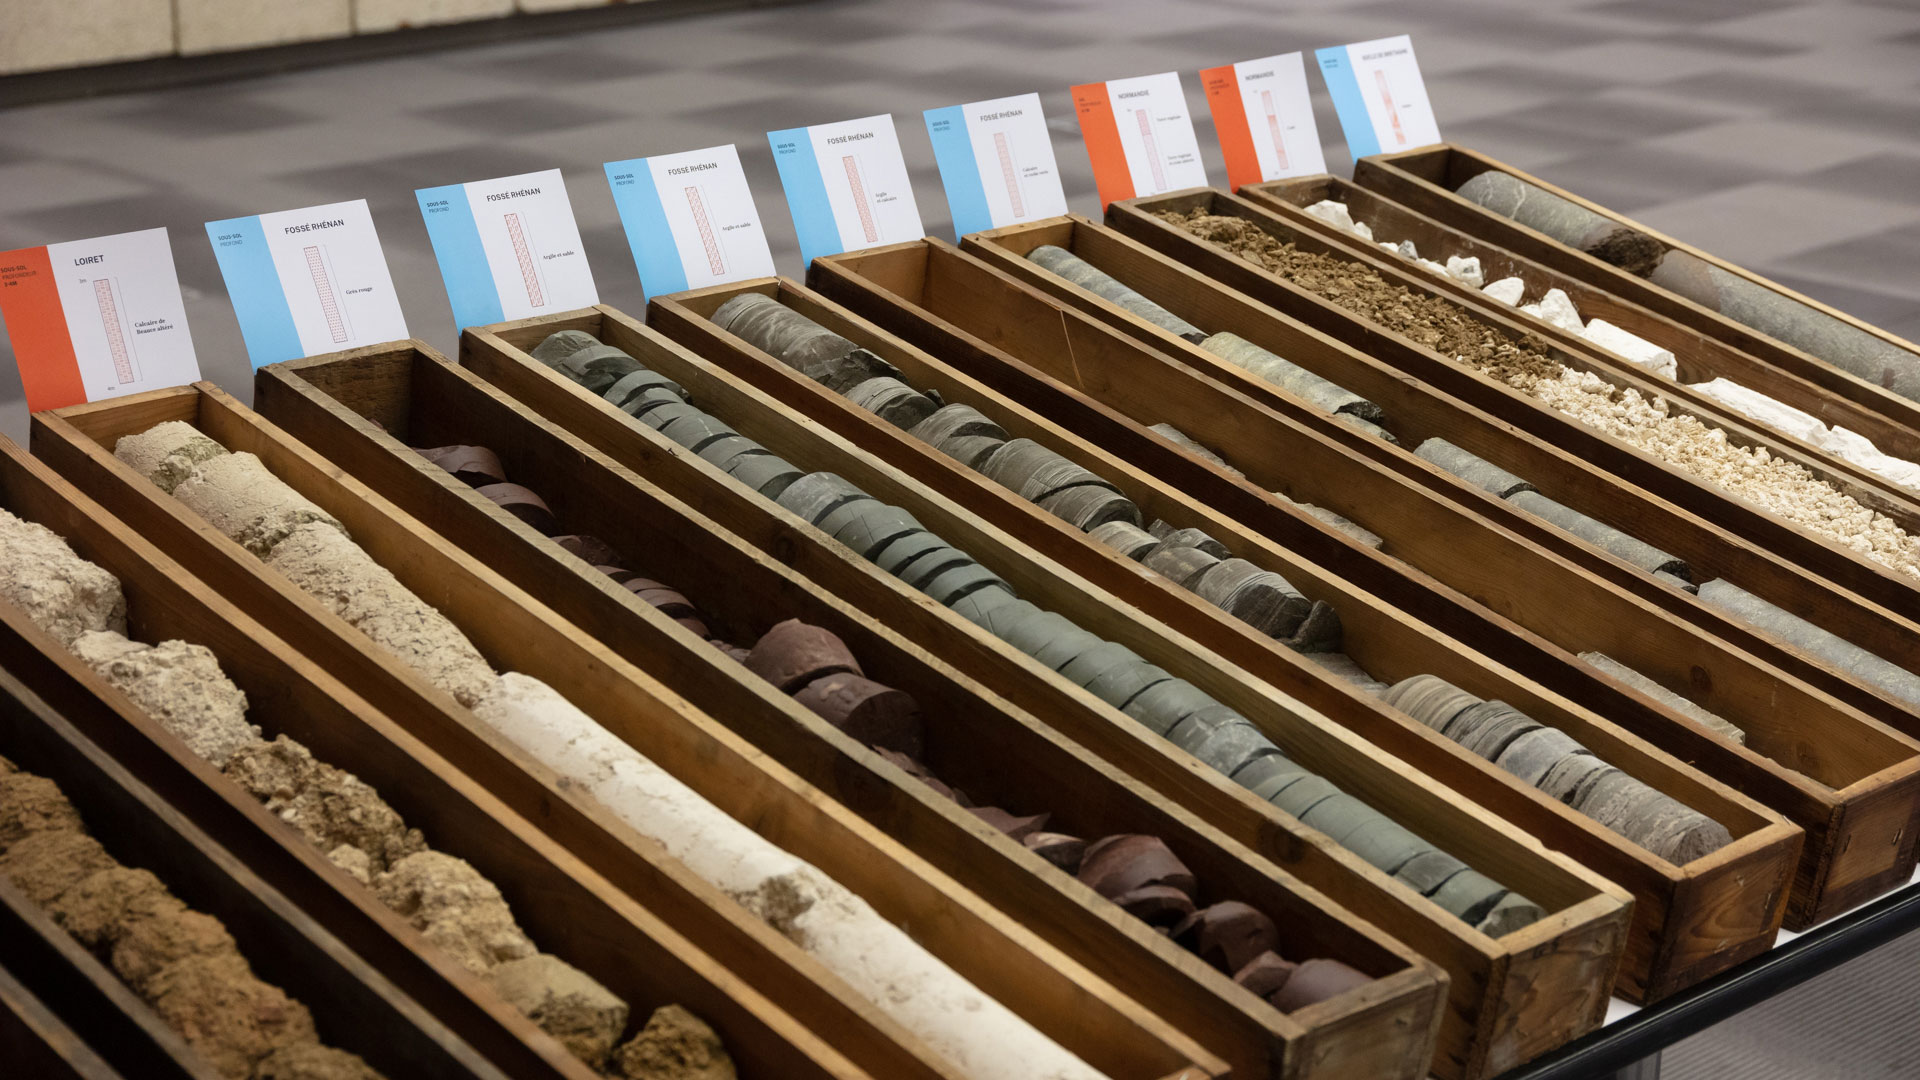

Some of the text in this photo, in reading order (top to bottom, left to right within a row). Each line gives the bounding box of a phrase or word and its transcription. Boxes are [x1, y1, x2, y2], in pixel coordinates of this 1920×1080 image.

[1118, 90, 1149, 100] NORMANDIE
[980, 110, 1023, 122] FOSSÉ RHÉNAN
[827, 132, 874, 145] FOSSÉ RHÉNAN
[668, 162, 718, 176] FOSSÉ RHÉNAN
[614, 173, 634, 181] SOUS-SOL
[486, 187, 541, 202] FOSSÉ RHÉNAN
[284, 219, 345, 235] FOSSÉ RHÉNAN
[218, 233, 243, 241] SOUS-SOL
[220, 240, 243, 248] PROFOND
[74, 254, 104, 266] LOIRET
[134, 319, 158, 328] Calcaire
